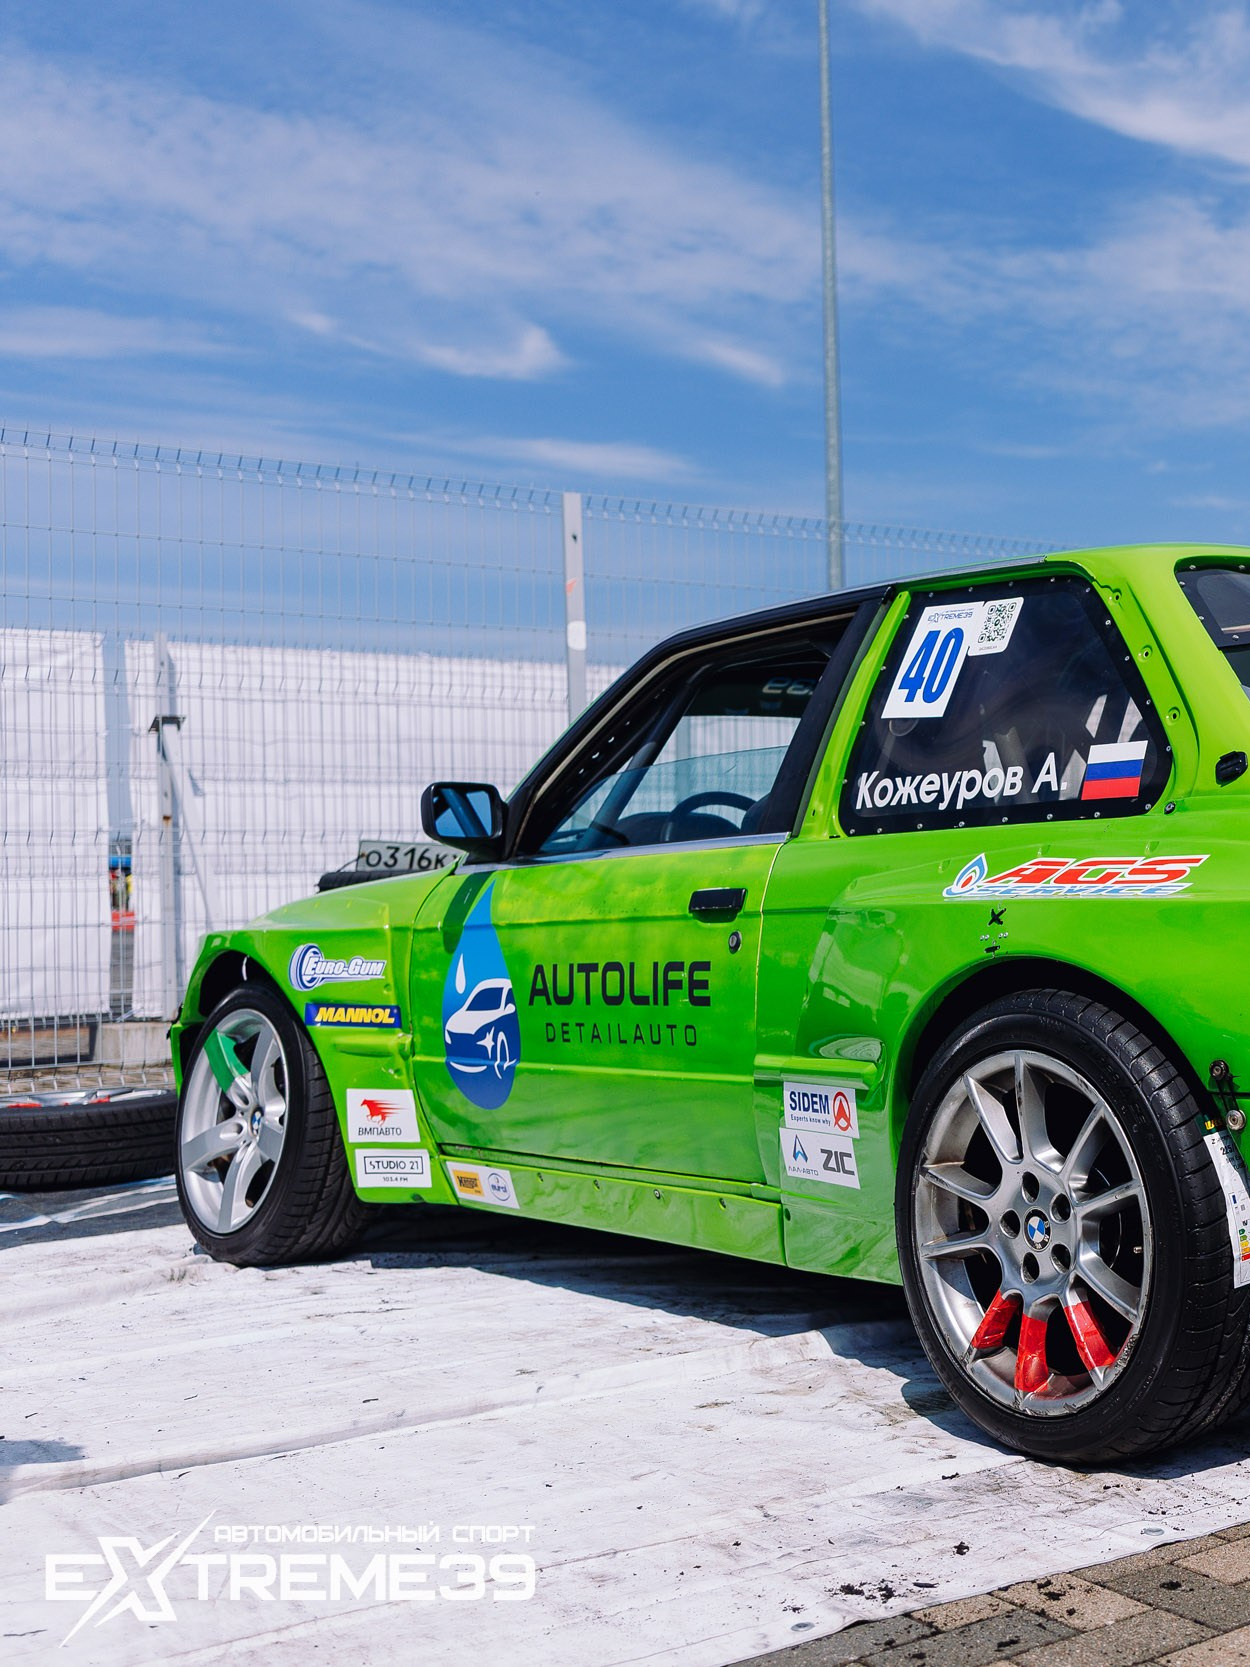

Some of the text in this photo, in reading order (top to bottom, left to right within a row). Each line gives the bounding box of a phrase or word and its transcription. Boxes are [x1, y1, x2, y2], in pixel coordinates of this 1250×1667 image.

[898, 627, 964, 703] 40
[855, 752, 1067, 810] Кожеуров А.
[984, 855, 1209, 885] AGS
[976, 884, 1188, 896] SERVICE
[528, 961, 711, 1007] AUTOLIFE
[314, 1007, 395, 1024] MANNOL
[546, 1022, 697, 1046] DETAILAUTO
[789, 1091, 830, 1115] SIDEM
[358, 1127, 402, 1136] ВМПАВТО
[822, 1118, 831, 1126] why
[369, 1160, 419, 1170] STUDIO 21
[820, 1148, 855, 1176] ZIC
